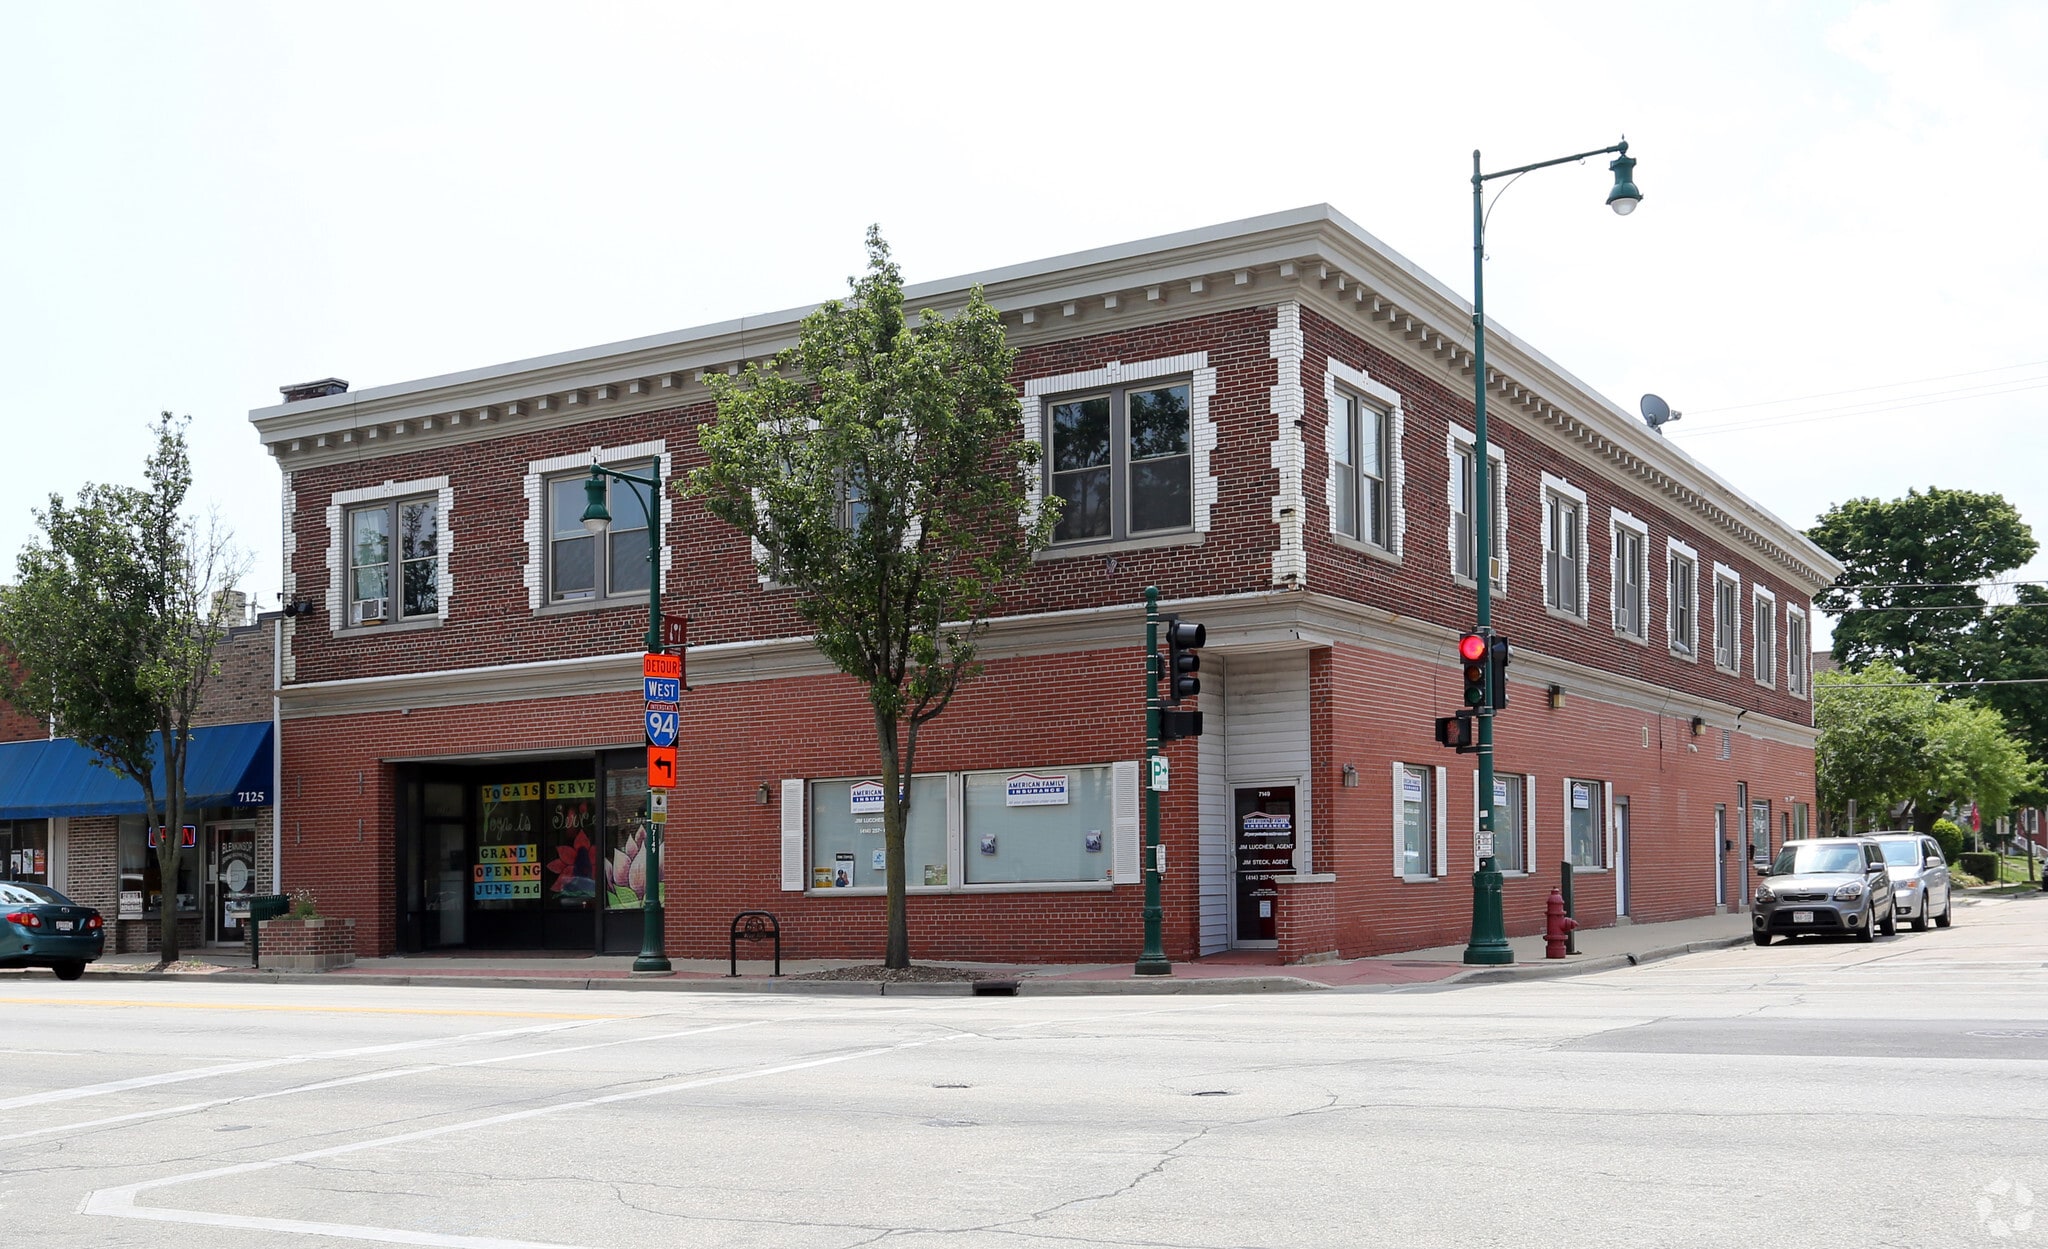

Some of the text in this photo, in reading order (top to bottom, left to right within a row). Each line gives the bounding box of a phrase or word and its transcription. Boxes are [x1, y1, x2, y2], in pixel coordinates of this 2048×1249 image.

[646, 659, 678, 673] DETOUR
[648, 681, 675, 698] WEST
[650, 703, 674, 711] INTERSTATE
[649, 712, 675, 739] 94
[549, 781, 596, 794] SERVE
[1008, 779, 1065, 788] AMERICAN FAMILY
[237, 791, 265, 802] 7125
[1012, 787, 1061, 795] INSURANCE
[476, 864, 541, 878] OPENING
